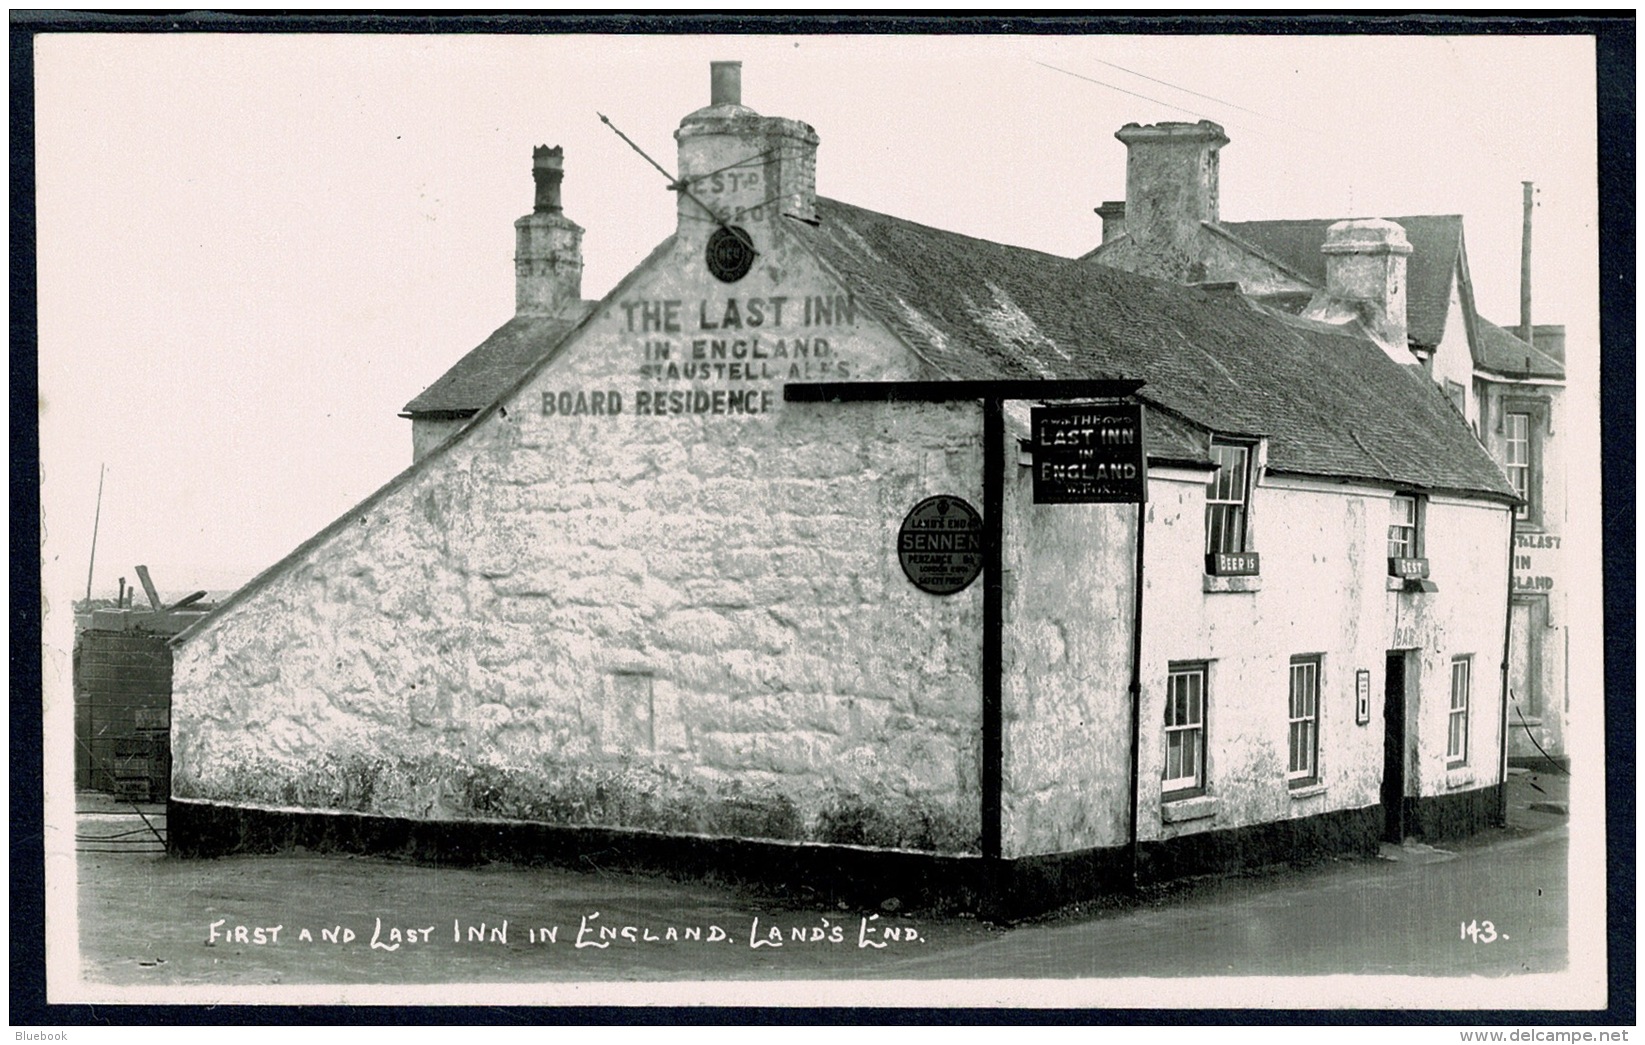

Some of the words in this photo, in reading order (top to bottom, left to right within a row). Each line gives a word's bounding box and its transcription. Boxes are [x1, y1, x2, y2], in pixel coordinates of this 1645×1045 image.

[620, 300, 682, 332] THE
[701, 297, 787, 330] LAST
[804, 295, 855, 327] INN
[644, 340, 670, 360] IN
[667, 361, 774, 380] AUSTELL
[541, 391, 622, 416] BOARD
[636, 389, 773, 416] RESIDENCE
[1071, 415, 1101, 425] THE
[1041, 427, 1094, 446] LAST
[1101, 428, 1134, 445] INN
[1079, 449, 1094, 459] IN
[1041, 462, 1137, 481] ENGLAND
[947, 518, 967, 529] END
[902, 533, 980, 550] SENNEN
[908, 554, 953, 564] PENZANCE
[1220, 554, 1245, 571] BEER
[1246, 558, 1255, 569] IS
[1401, 559, 1422, 573] BEST
[1515, 555, 1531, 569] IN
